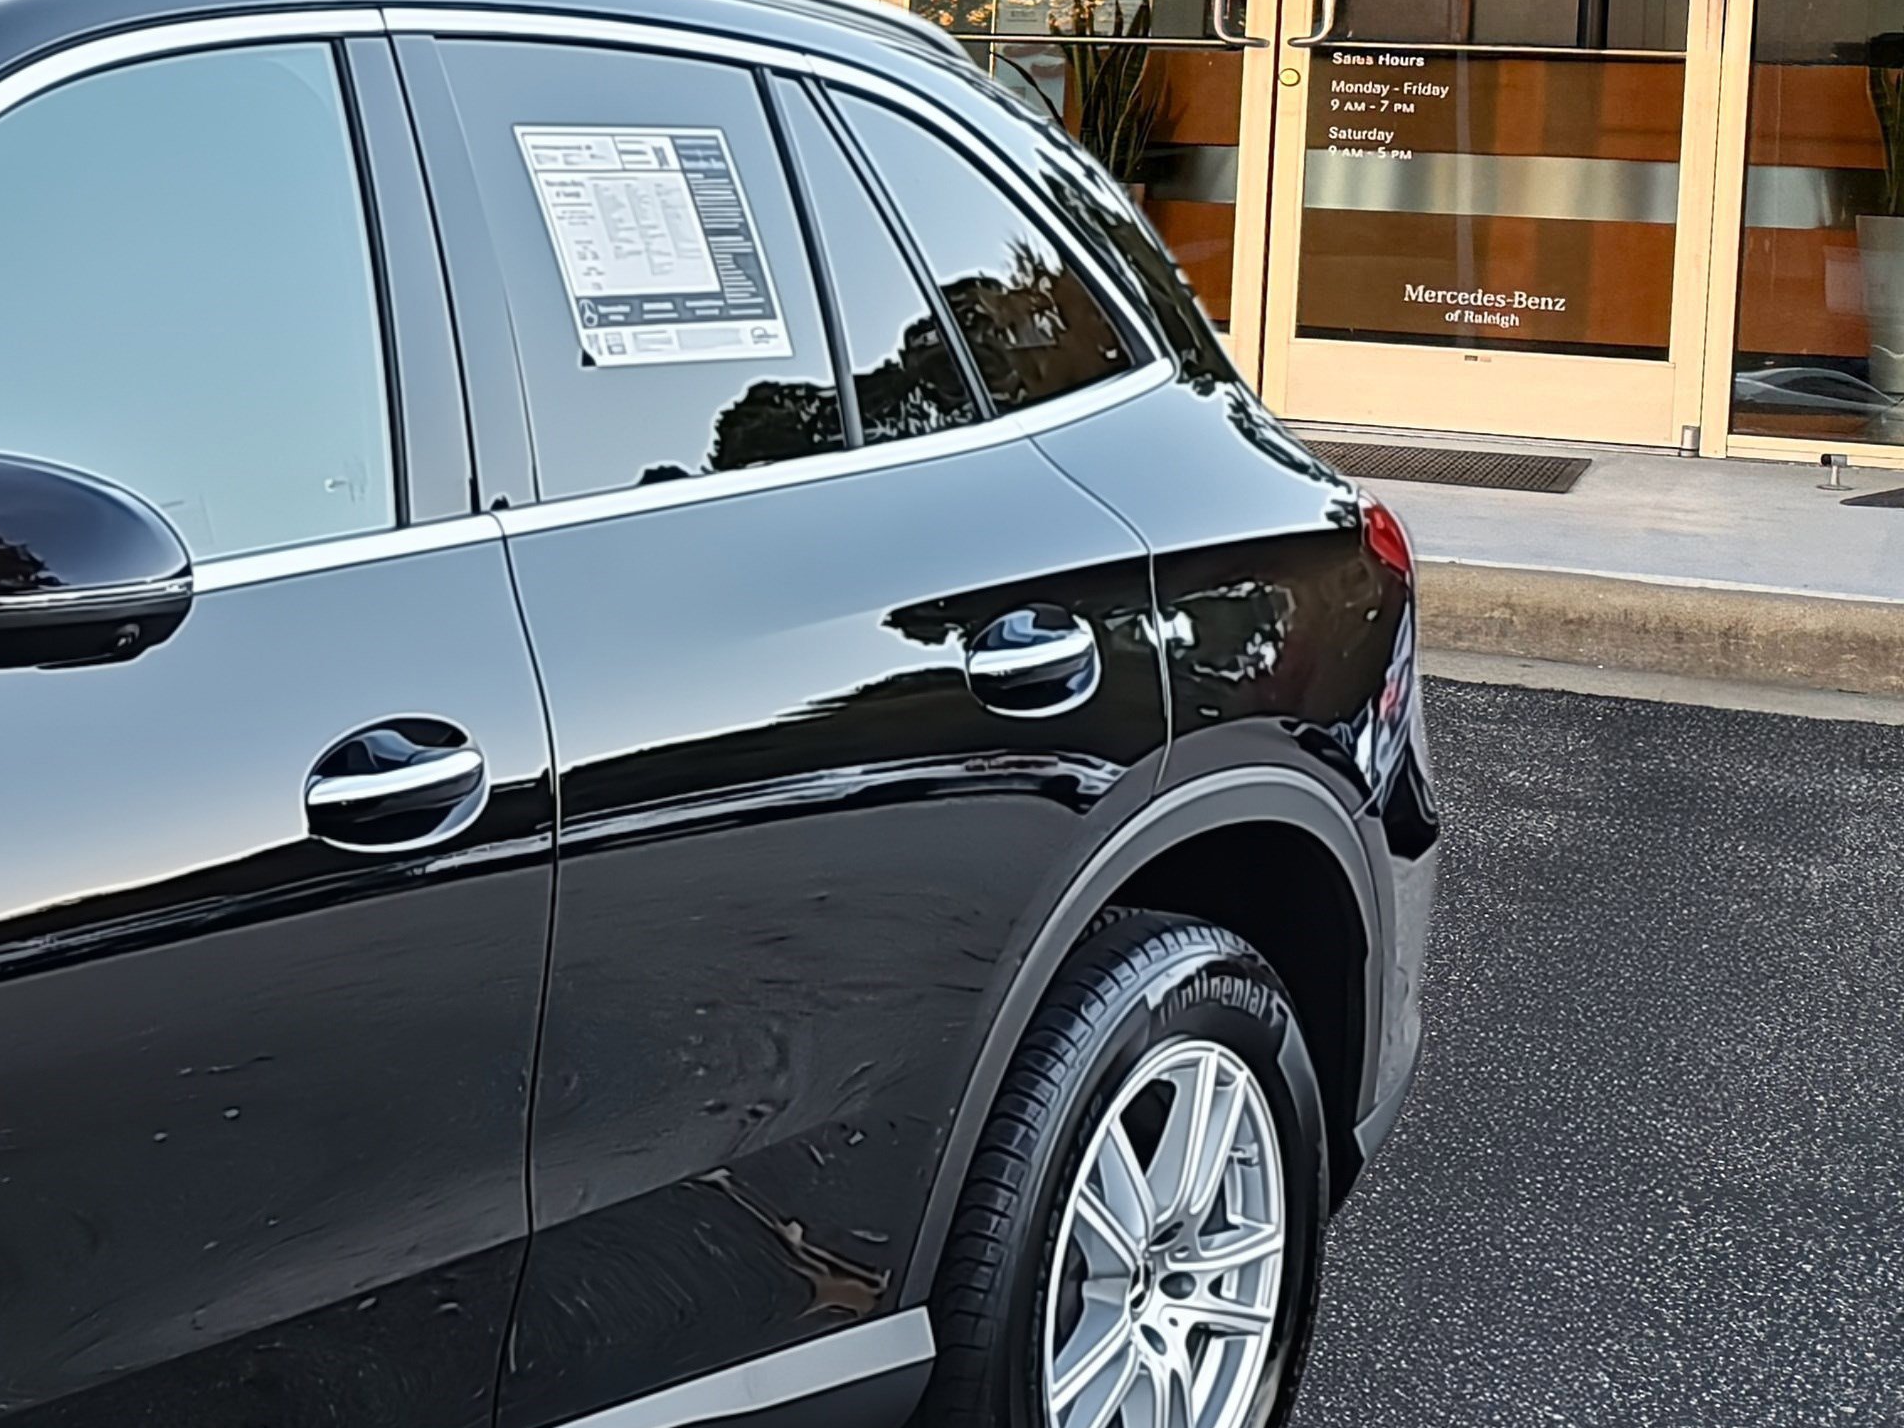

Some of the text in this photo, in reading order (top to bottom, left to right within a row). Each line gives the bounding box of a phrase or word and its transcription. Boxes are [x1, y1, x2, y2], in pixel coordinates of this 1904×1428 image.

[1378, 53, 1425, 67] Hours
[1331, 80, 1390, 97] Monday
[1403, 82, 1449, 98] Friday
[1330, 99, 1340, 111] 9
[1344, 101, 1366, 112] AM
[1380, 100, 1390, 112] 7
[1393, 103, 1415, 113] PM
[1328, 126, 1394, 143] Saturday
[1328, 145, 1337, 158] 9
[1342, 148, 1364, 158] AM
[1377, 147, 1386, 159] 5
[1391, 149, 1412, 160] PM
[1403, 283, 1566, 312] Mercedes-Benz
[1445, 310, 1520, 328] of Raleigh
